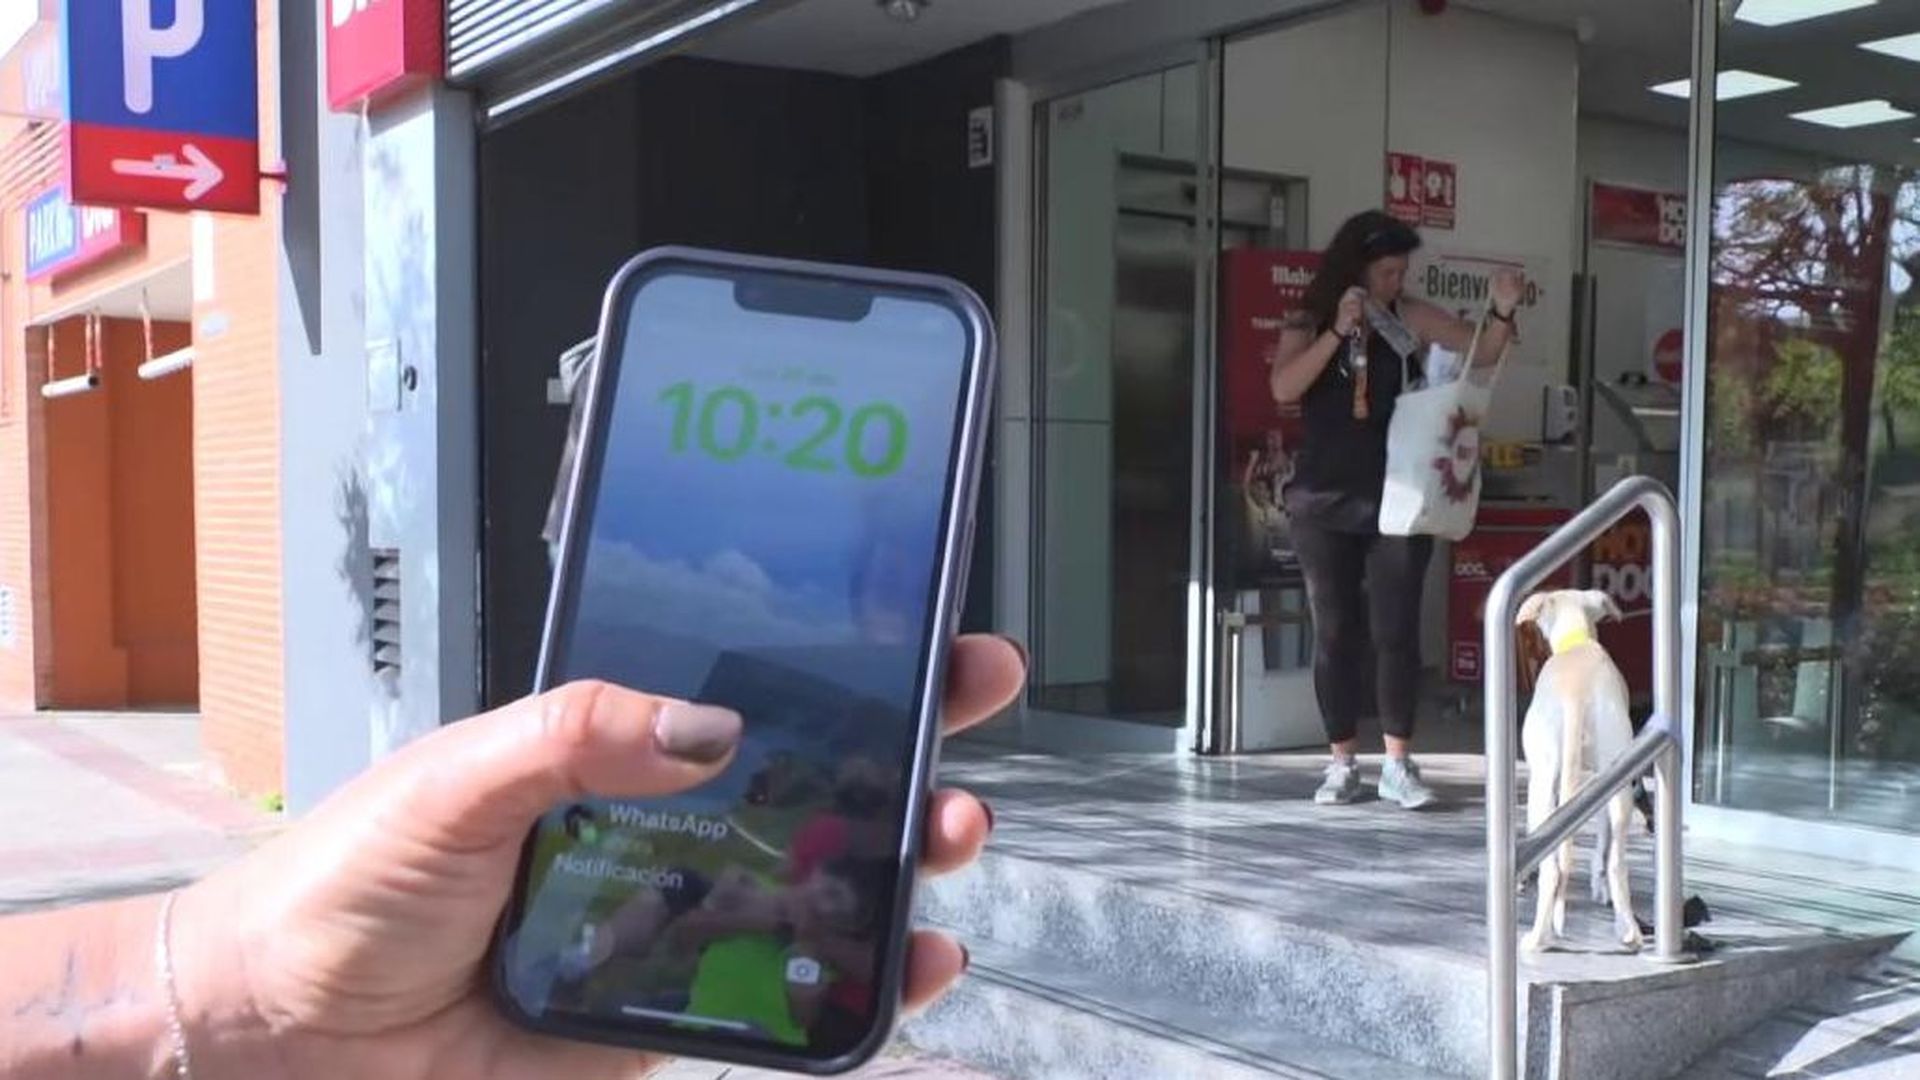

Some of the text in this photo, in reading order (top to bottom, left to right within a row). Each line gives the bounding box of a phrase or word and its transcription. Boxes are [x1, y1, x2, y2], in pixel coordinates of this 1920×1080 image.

[121, 0, 205, 113] P
[1656, 194, 1687, 222] HO
[1658, 223, 1687, 244] DO
[660, 381, 908, 478] 10:20
[609, 803, 729, 841] WhatsApp
[553, 852, 685, 889] Notificación
